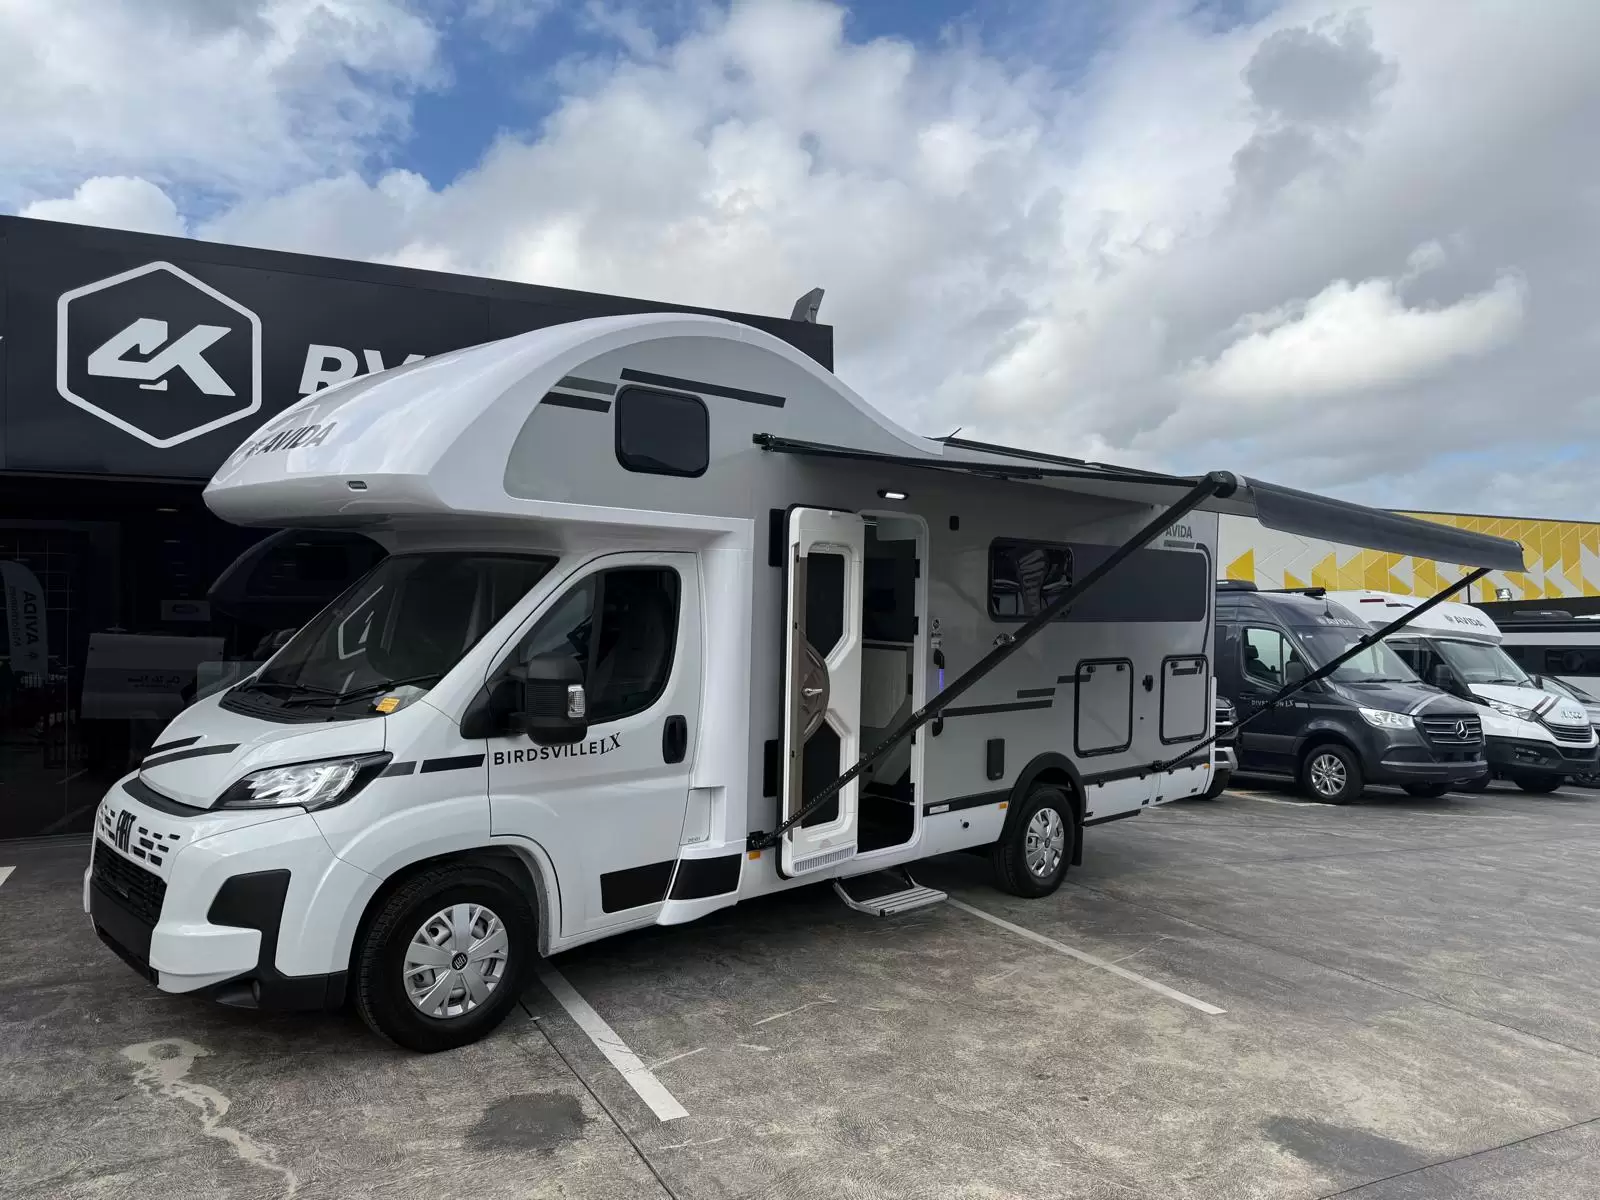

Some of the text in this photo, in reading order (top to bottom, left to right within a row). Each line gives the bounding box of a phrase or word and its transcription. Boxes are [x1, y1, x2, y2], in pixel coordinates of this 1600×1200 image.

[255, 421, 338, 455] AVIDA
[1165, 523, 1193, 539] AVIDA
[1453, 615, 1487, 628] AVIDA
[494, 732, 621, 766] BIRDSVILLE LX
[115, 809, 137, 853] FIAT
